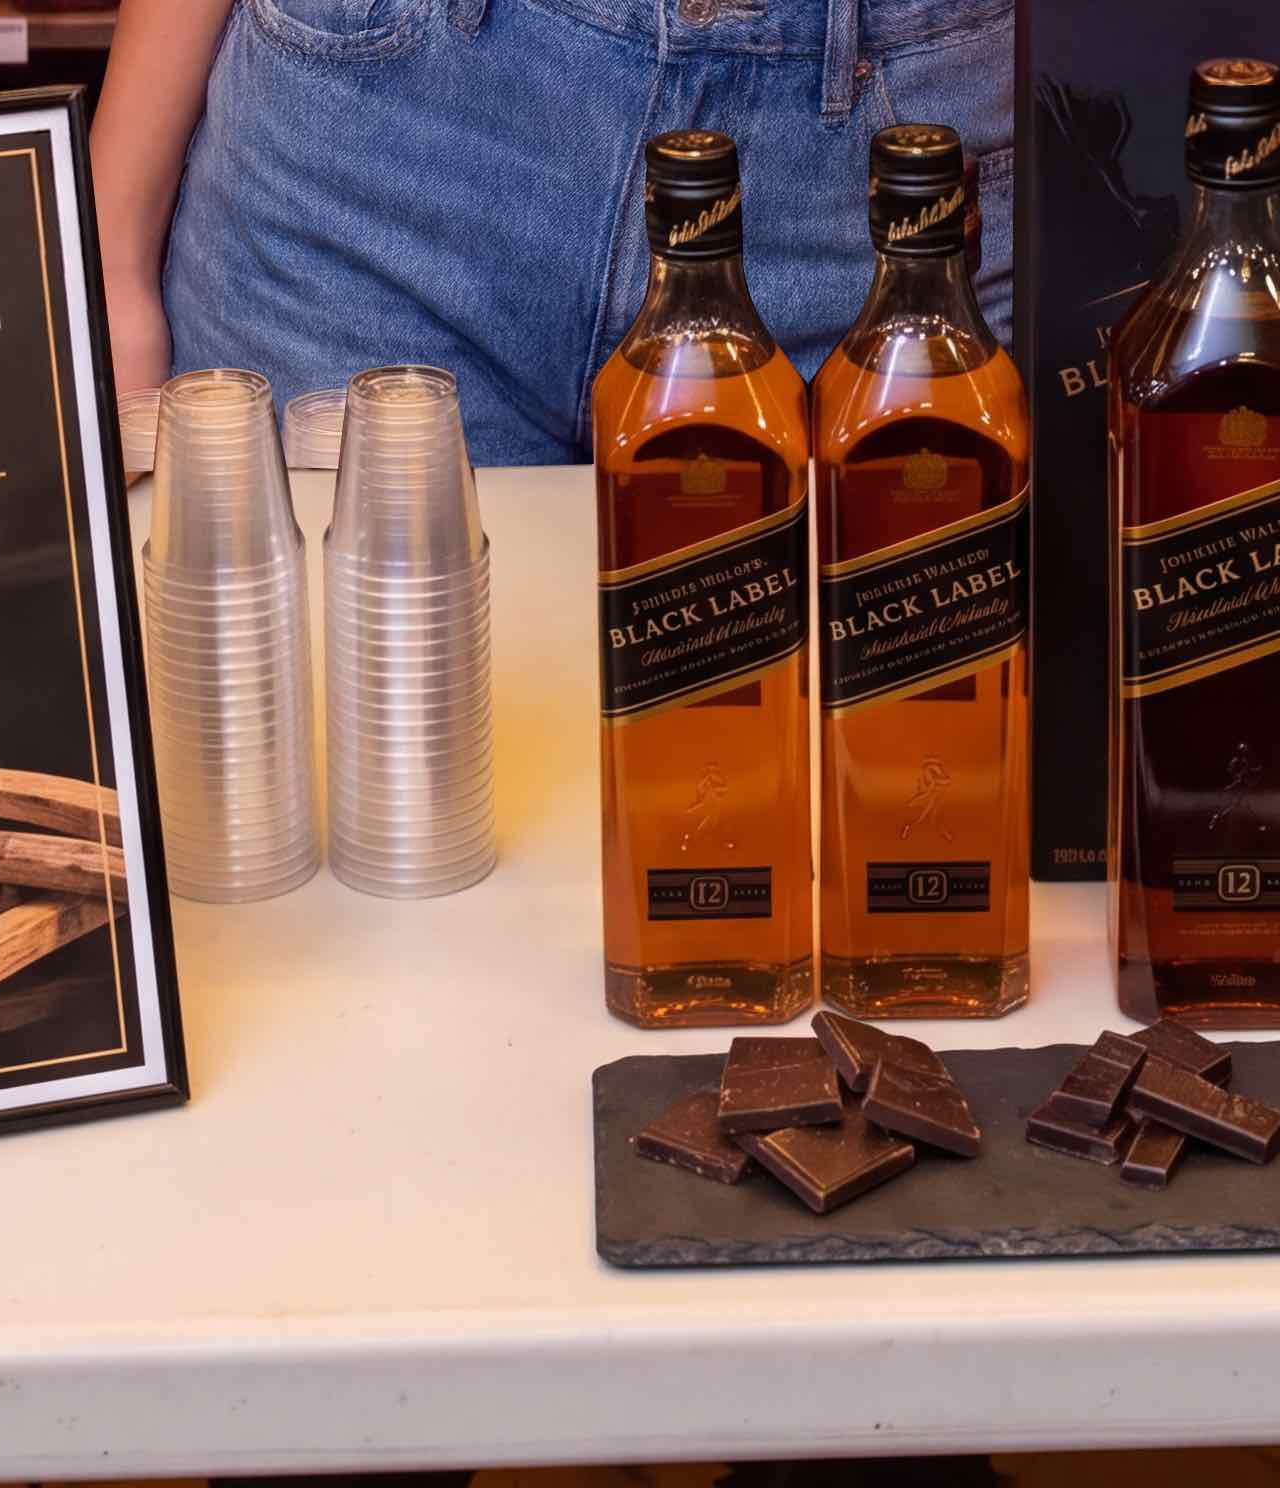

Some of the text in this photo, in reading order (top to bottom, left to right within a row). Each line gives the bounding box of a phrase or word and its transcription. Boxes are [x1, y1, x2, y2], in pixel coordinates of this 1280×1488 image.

[829, 597, 922, 640] BLACK
[930, 559, 1022, 609] LABEL
[1133, 563, 1240, 611] BLACK
[609, 607, 702, 649] BLACK
[711, 567, 797, 614] LABEL
[696, 878, 721, 903] 12
[916, 873, 942, 898] 12
[1226, 871, 1252, 896] 12
